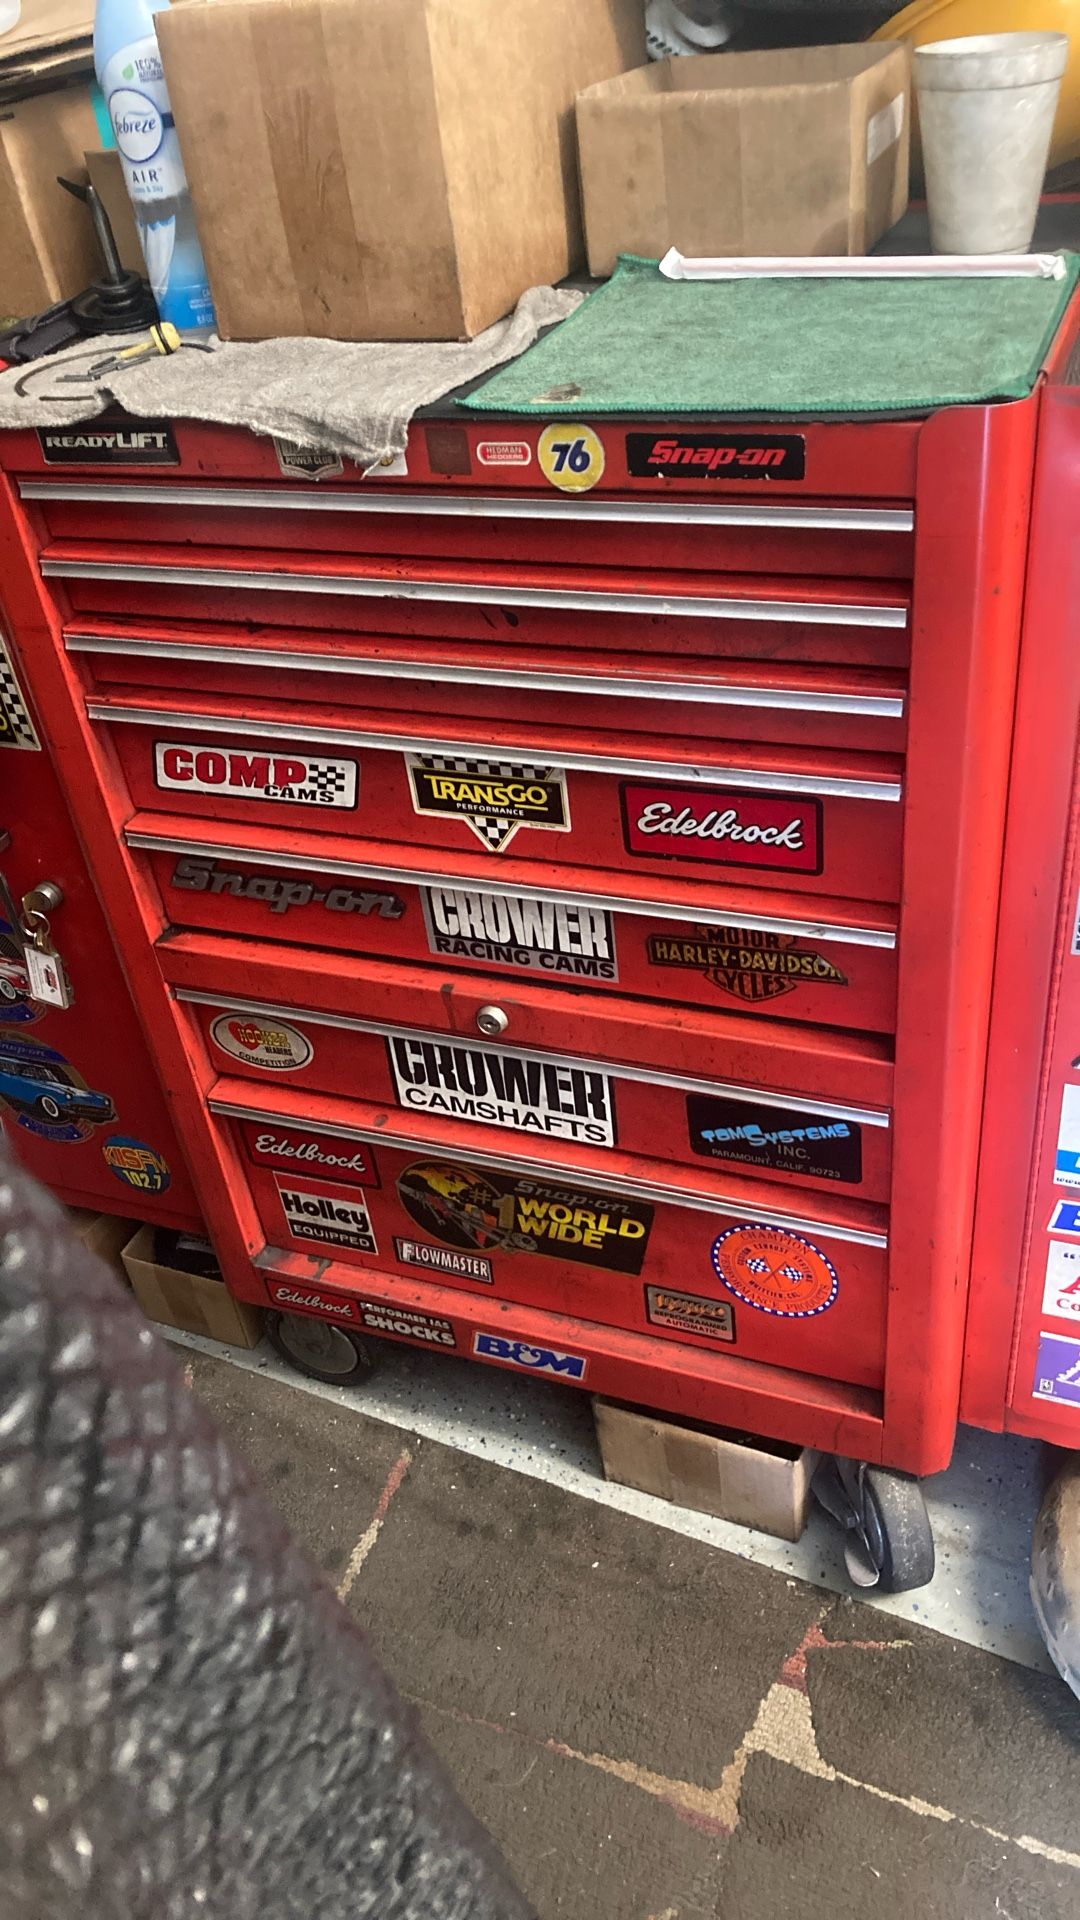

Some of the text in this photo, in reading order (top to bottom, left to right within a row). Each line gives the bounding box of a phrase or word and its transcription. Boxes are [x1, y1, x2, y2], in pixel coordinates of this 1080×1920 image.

[132, 168, 158, 183] AIR
[46, 432, 166, 448] READYLIFT
[551, 439, 590, 472] 76
[648, 440, 786, 470] Snap-on
[163, 748, 306, 789] COMP
[264, 785, 335, 803] CAMS
[456, 802, 525, 817] PERFORMANCE
[637, 802, 813, 849] Edelbrock
[171, 858, 405, 919] Snap-on
[430, 886, 611, 960] CROWER
[707, 927, 780, 949] MOTOR
[435, 936, 615, 979] RACING CAMS
[713, 967, 786, 999] CYCLES
[239, 1051, 296, 1067] COMPETITION
[392, 1037, 607, 1121] CROWER
[405, 1088, 607, 1142] CAMSHAFTS
[255, 1135, 366, 1172] Edelbrock
[712, 1148, 772, 1167] PARAMOUNT,
[809, 1166, 841, 1178] 90723
[777, 1144, 811, 1160] INC.
[122, 1170, 161, 1190] 102.7
[280, 1191, 370, 1233] Holley
[513, 1179, 631, 1215] Snap-on
[518, 1196, 646, 1239] WORLD
[518, 1214, 607, 1250] WIDE
[293, 1224, 370, 1247] EQUIPPED
[740, 1230, 808, 1255] CHAMPION
[402, 1242, 488, 1277] FLOWMASTER
[276, 1287, 353, 1317] Edelbrock
[360, 1302, 426, 1324] PERFORMER
[364, 1313, 456, 1346] SHOCKS
[654, 1309, 728, 1331] REPROGRAMMED
[665, 1318, 719, 1335] AUTOMATIC
[476, 1334, 585, 1378] B&M
